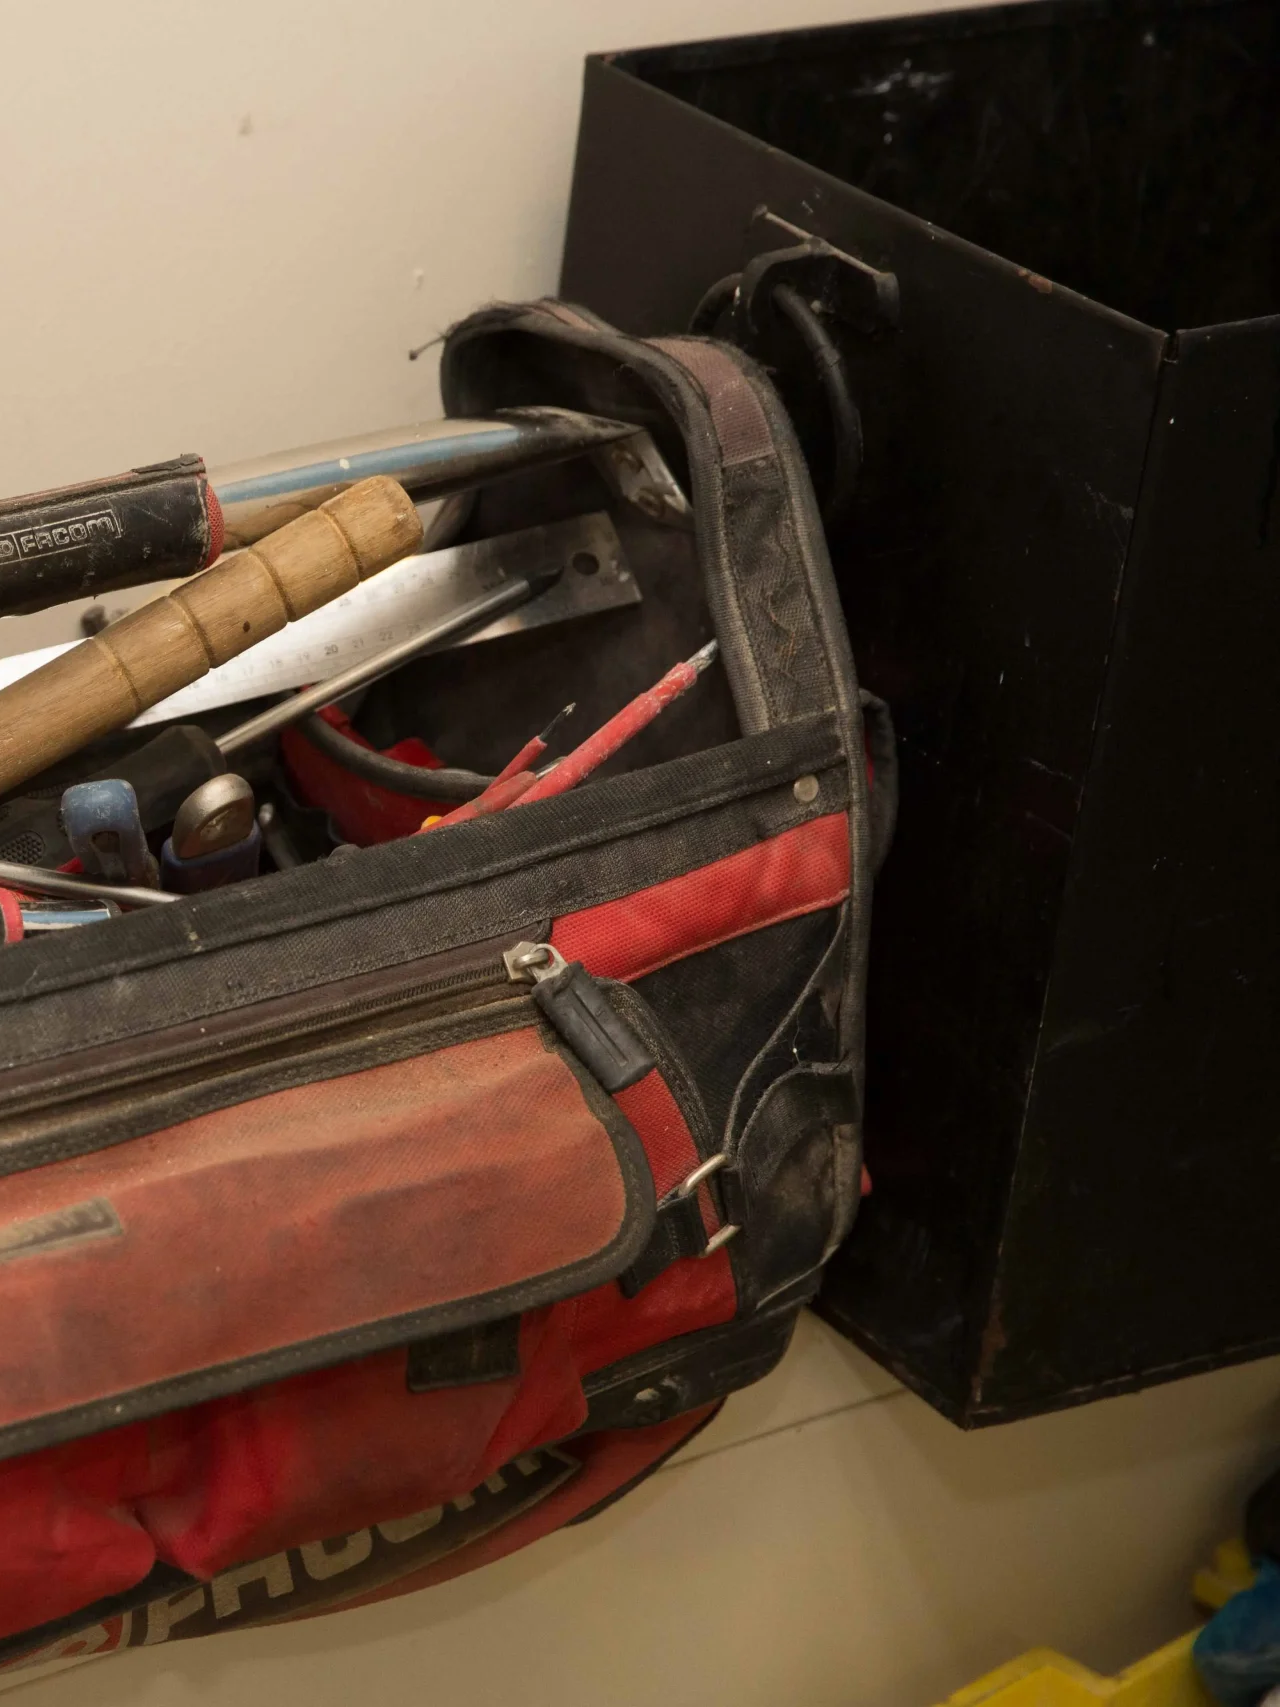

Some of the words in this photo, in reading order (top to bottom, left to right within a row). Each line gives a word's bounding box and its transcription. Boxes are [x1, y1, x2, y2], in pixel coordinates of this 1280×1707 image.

[20, 516, 115, 553] FACOM
[323, 643, 339, 656] 20
[351, 637, 365, 649] 21
[378, 630, 394, 643] 22
